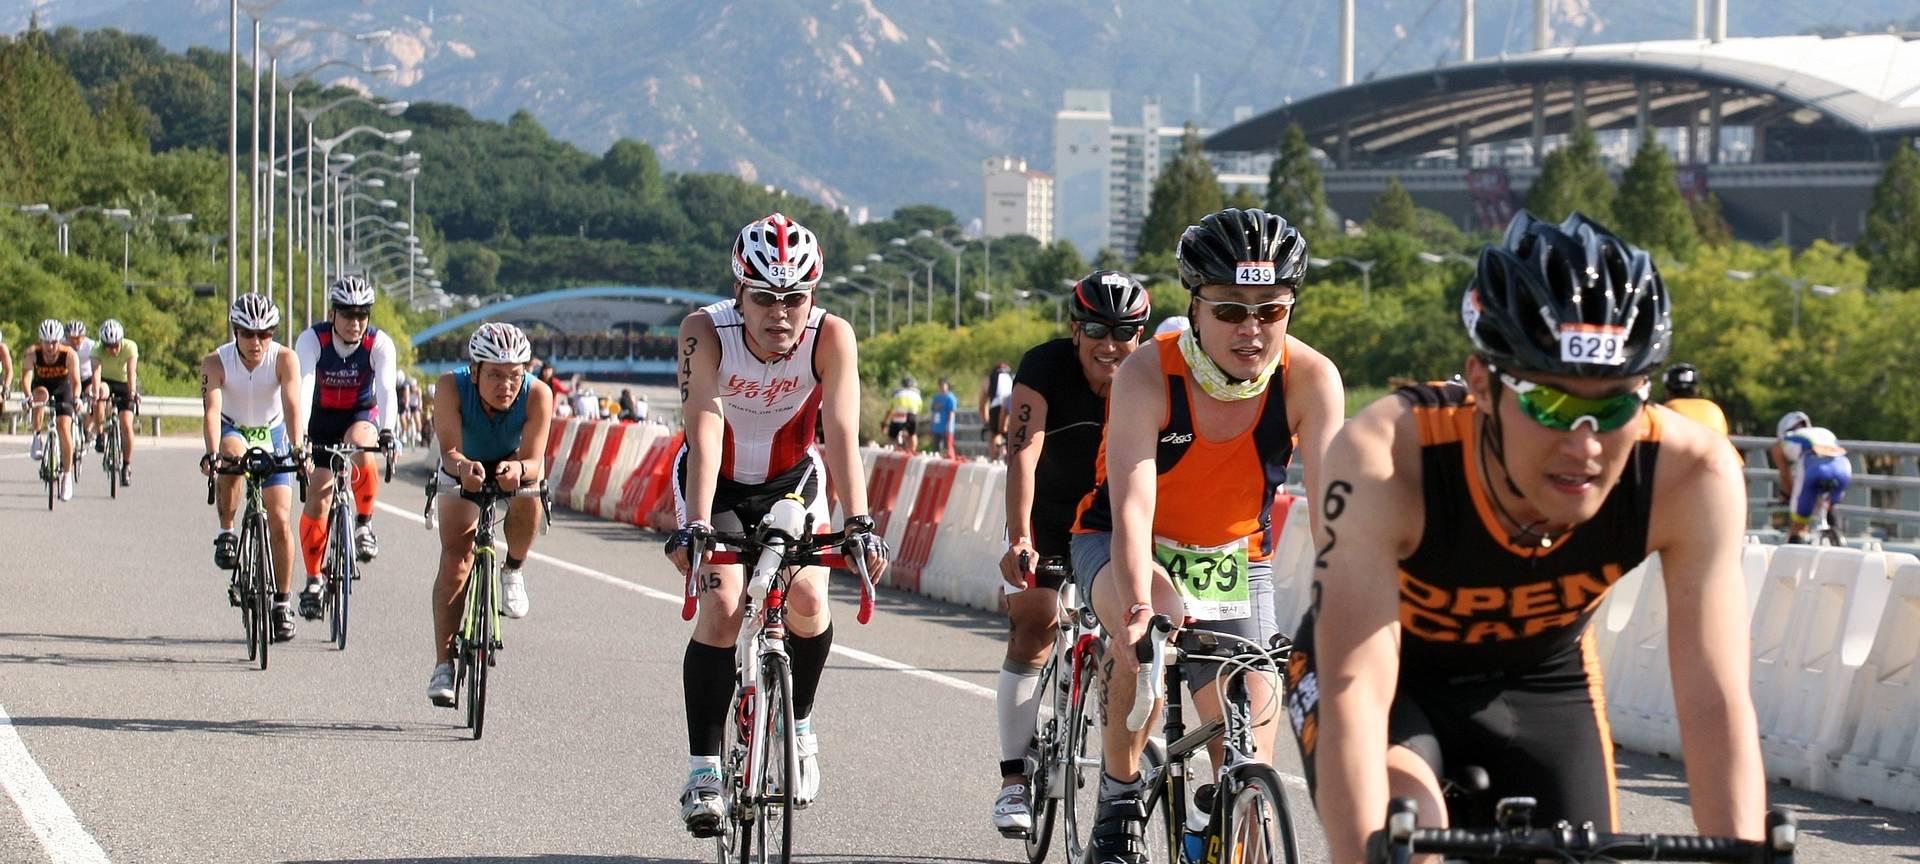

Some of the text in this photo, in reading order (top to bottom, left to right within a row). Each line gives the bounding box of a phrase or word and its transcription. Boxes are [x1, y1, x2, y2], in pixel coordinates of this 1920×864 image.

[771, 266, 795, 277] 345
[1240, 268, 1271, 282] 439
[1569, 336, 1617, 360] 629
[683, 336, 698, 404] 345
[1013, 404, 1032, 455] 347
[1167, 553, 1239, 593] 439
[1398, 562, 1623, 619] OPEN
